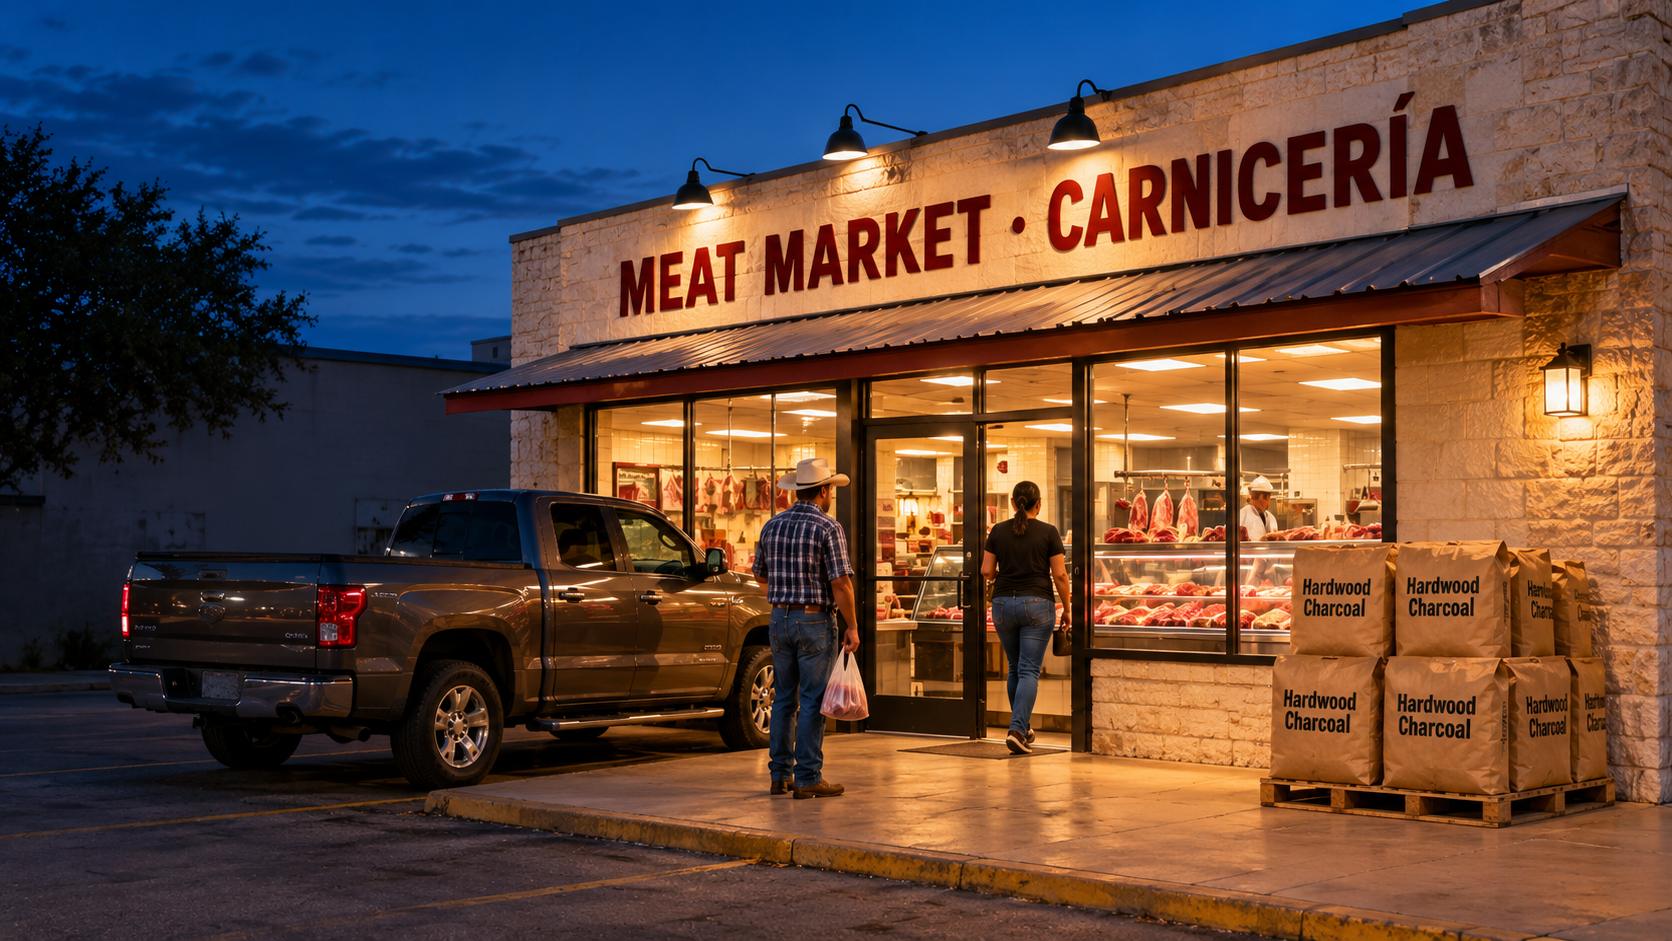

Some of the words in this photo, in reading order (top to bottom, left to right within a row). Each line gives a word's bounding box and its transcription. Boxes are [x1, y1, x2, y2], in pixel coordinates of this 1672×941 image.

[619, 240, 746, 318] MEAT
[764, 194, 992, 297] MARKET
[1048, 90, 1474, 253] CARNICERÍA
[1302, 578, 1371, 596] Hardwood
[1406, 575, 1480, 595] Hardwood
[1303, 599, 1366, 617] Charcoal
[1408, 597, 1475, 617] Charcoal
[1283, 689, 1357, 711] Hardwood
[1397, 693, 1477, 715] Hardwood
[1526, 693, 1568, 714] Hardwood
[1284, 711, 1351, 734] Charcoal
[1398, 715, 1471, 740] Charcoal
[1529, 715, 1567, 738] Charcoal
